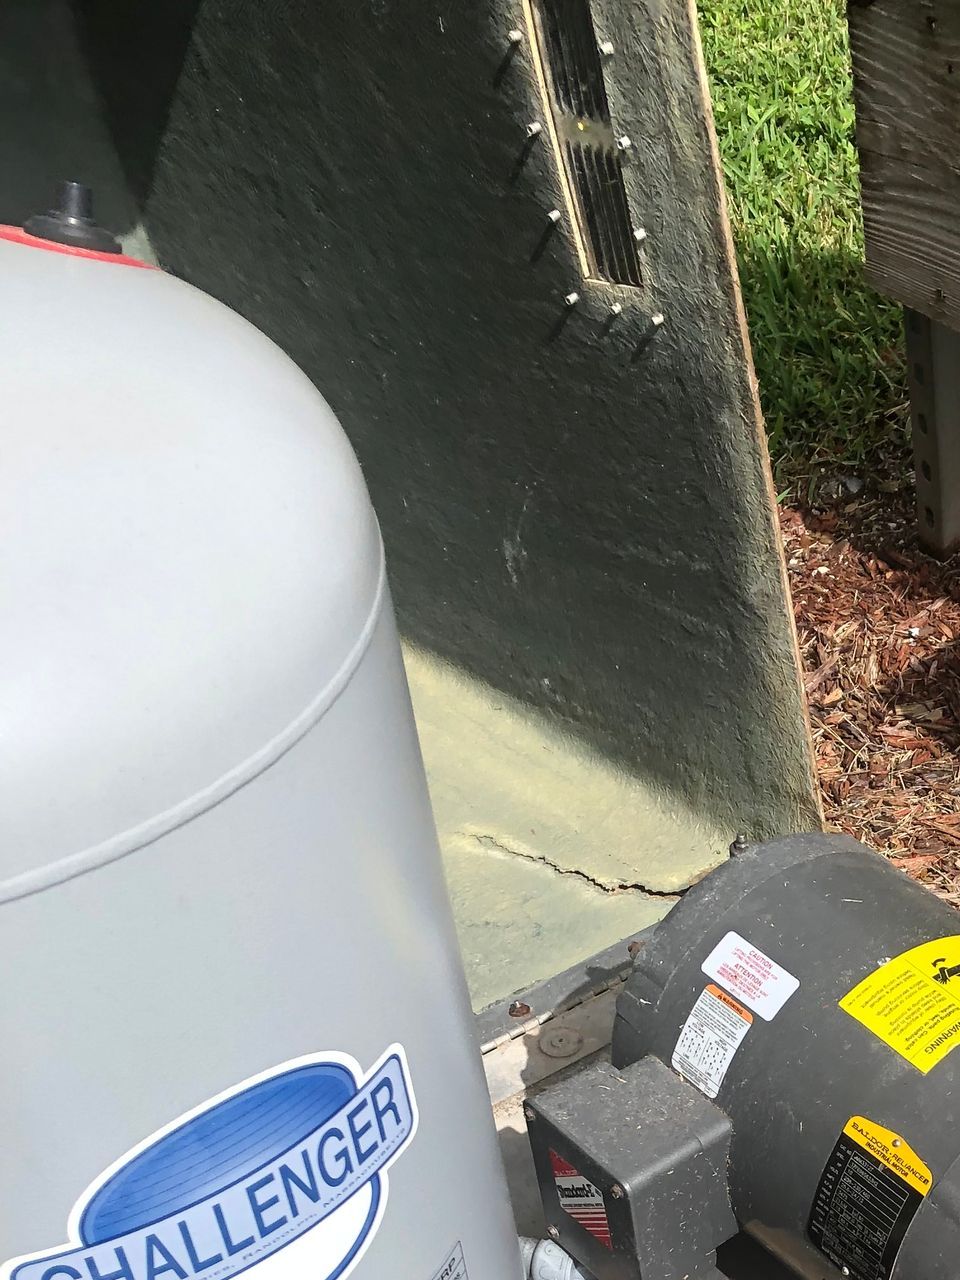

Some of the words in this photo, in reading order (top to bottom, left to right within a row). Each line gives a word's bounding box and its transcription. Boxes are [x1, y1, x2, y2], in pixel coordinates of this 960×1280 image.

[748, 948, 773, 970] CAUTION
[733, 962, 763, 987] ATTENTION
[851, 1121, 889, 1154] BALDOR
[865, 1140, 892, 1165] INDUSTRIAL
[892, 1161, 908, 1178] MOTOR
